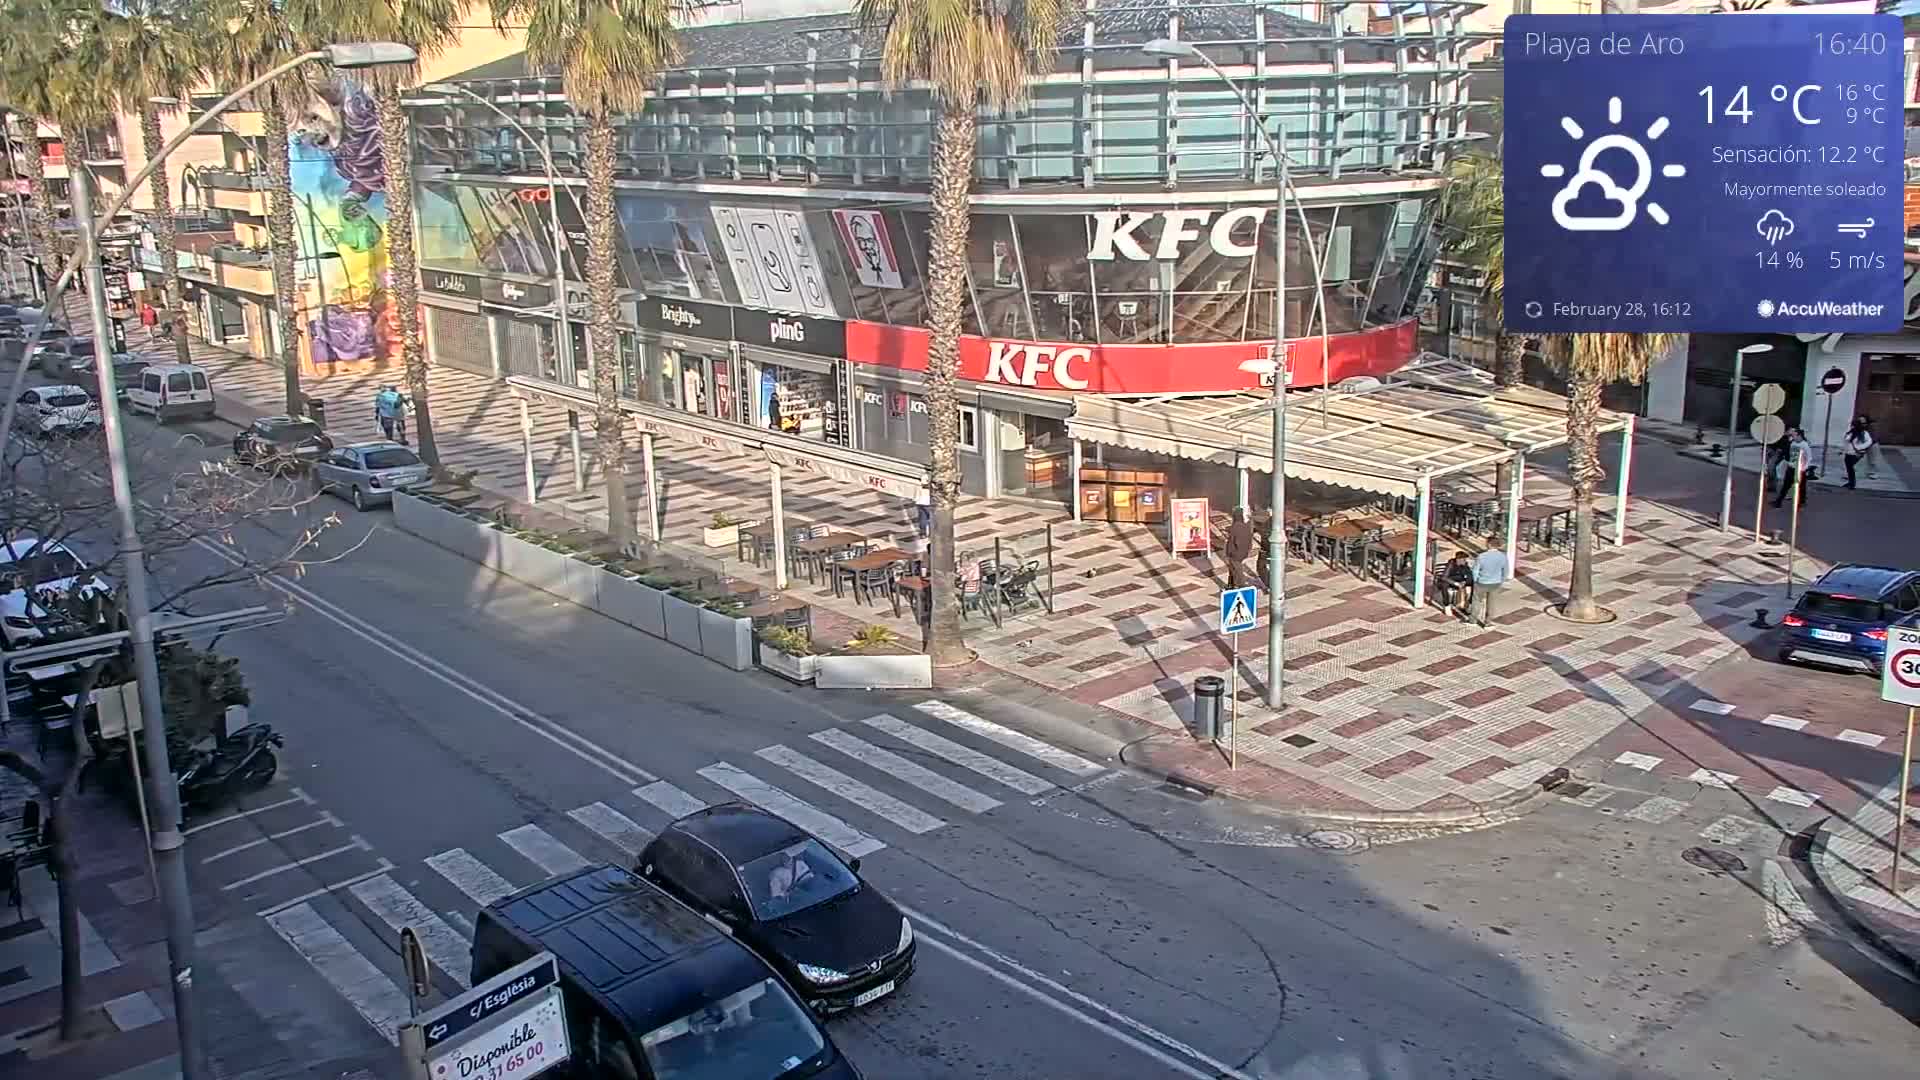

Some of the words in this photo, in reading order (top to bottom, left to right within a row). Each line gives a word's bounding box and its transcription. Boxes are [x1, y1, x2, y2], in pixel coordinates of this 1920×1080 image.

[1086, 207, 1268, 261] KFC
[770, 318, 804, 342] plinG
[984, 342, 1092, 389] KFC
[1265, 374, 1289, 385] KC
[864, 392, 883, 405] KFC
[868, 476, 887, 489] KFC
[1899, 632, 1920, 644] ZO
[456, 1022, 537, 1078] Disponible
[506, 1051, 525, 1072] 65
[526, 1041, 544, 1060] 00
